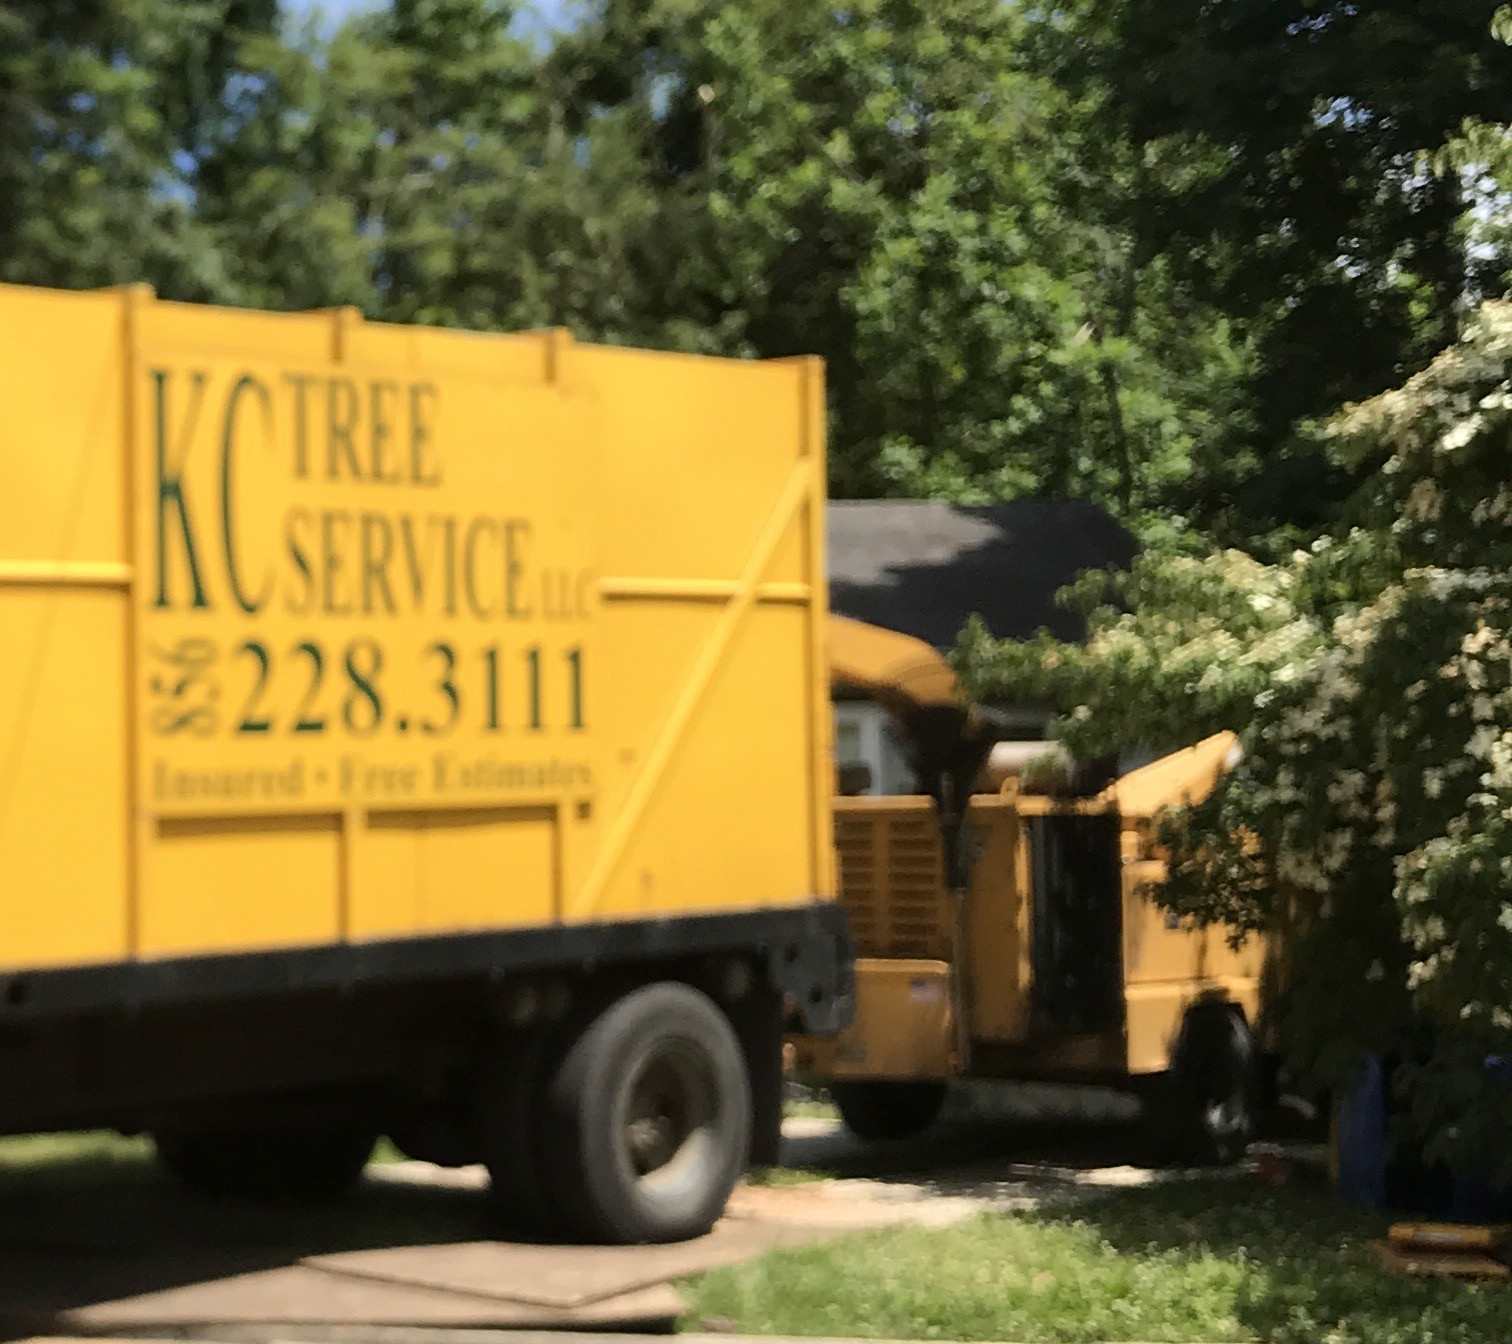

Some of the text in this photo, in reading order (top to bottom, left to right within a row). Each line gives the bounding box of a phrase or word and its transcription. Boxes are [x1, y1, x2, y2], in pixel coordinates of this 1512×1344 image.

[149, 369, 443, 614] KC TREE
[284, 504, 534, 621] SERVICE
[234, 639, 588, 738] 228.3111
